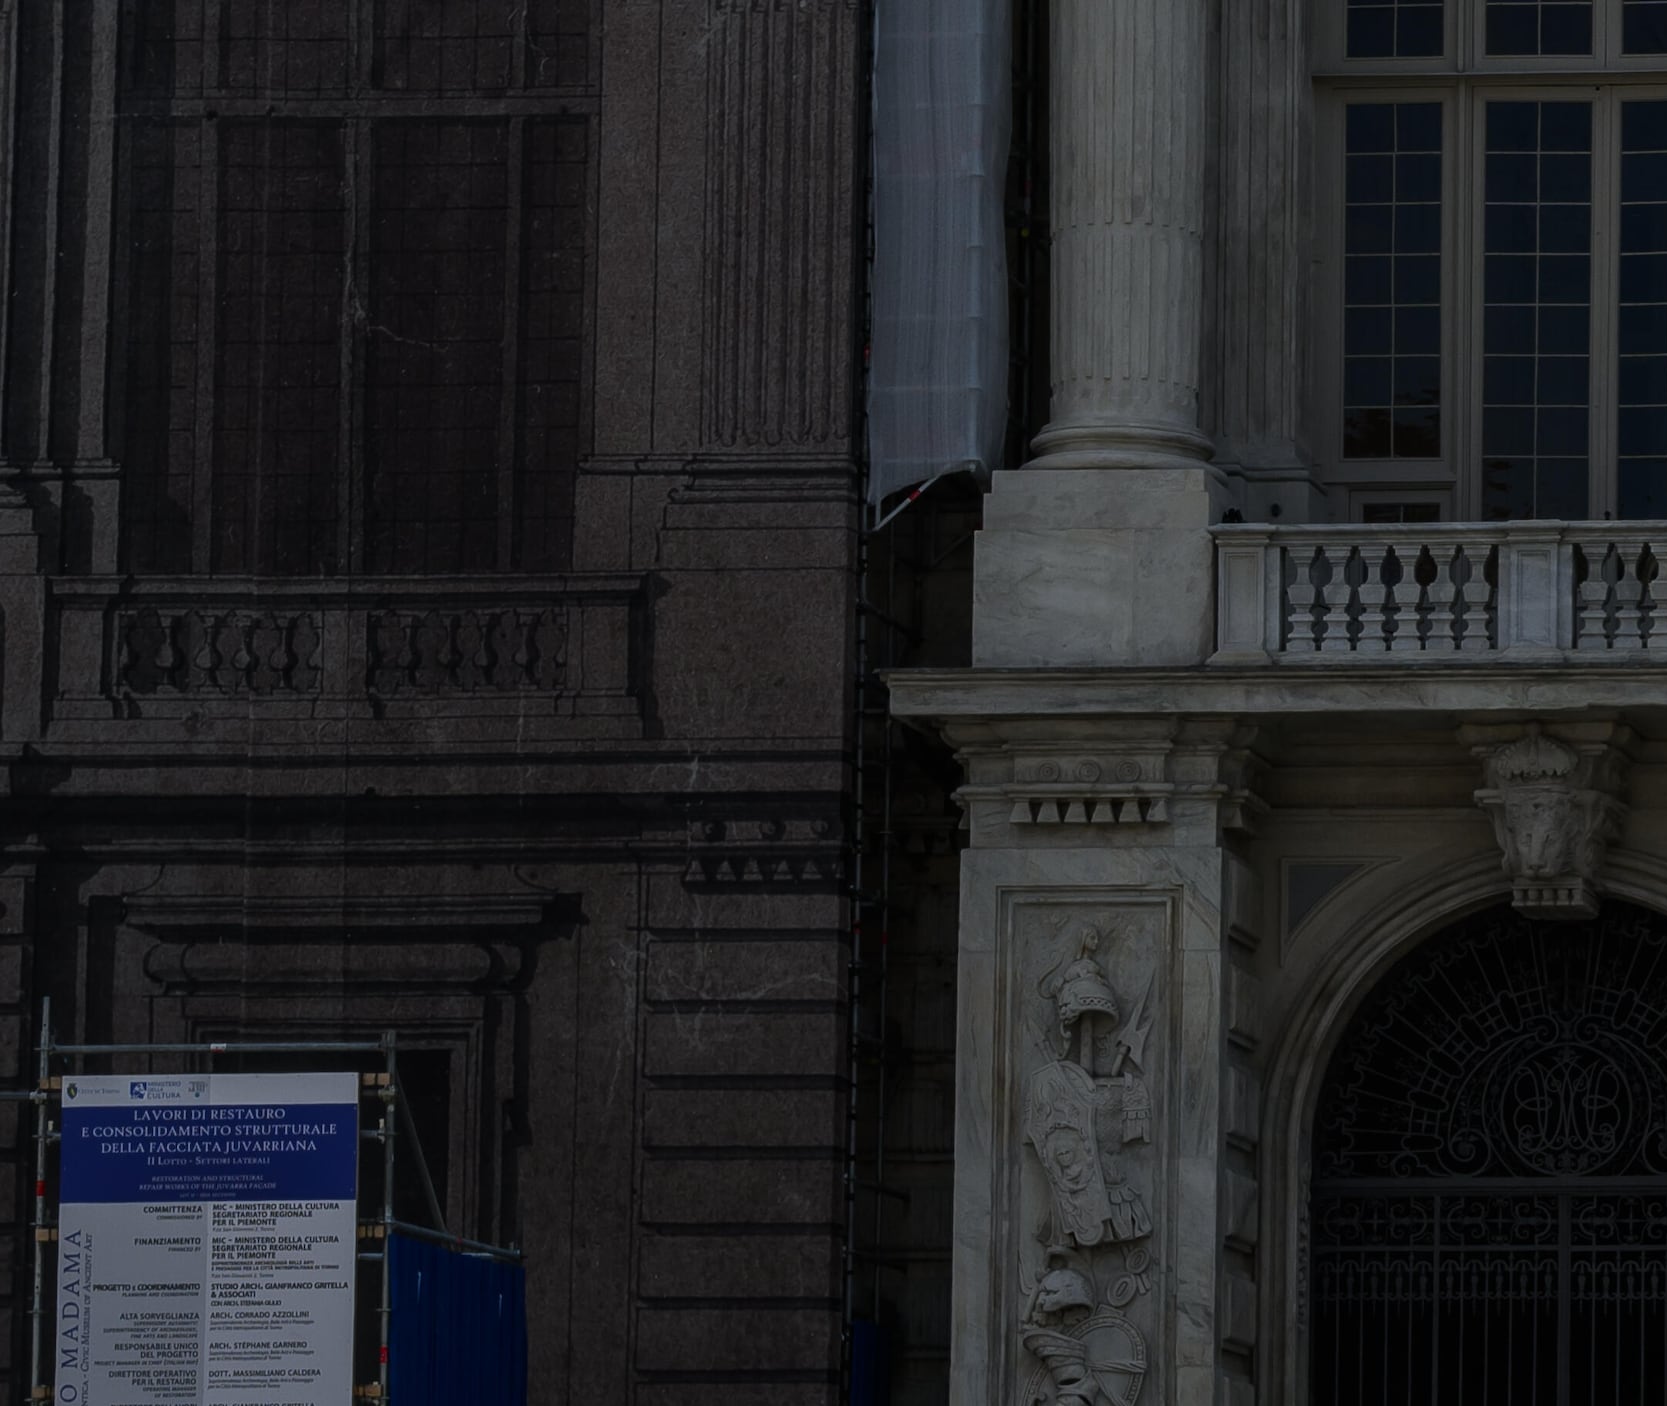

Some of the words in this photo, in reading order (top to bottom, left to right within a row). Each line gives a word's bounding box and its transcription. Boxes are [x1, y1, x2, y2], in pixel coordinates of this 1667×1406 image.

[134, 1109, 186, 1120] LAVORI
[192, 1109, 205, 1120] DI
[212, 1108, 285, 1120] RESTAURO
[82, 1126, 89, 1138] E
[93, 1125, 232, 1138] CONSOLIDAMENTO
[234, 1124, 336, 1136] STRUTTURALE
[101, 1141, 143, 1154] DELLA
[150, 1140, 220, 1153] FACCIATA
[227, 1140, 316, 1153] JUVARRIANA
[213, 1218, 226, 1226] PER
[61, 1228, 81, 1371] MADAMA
